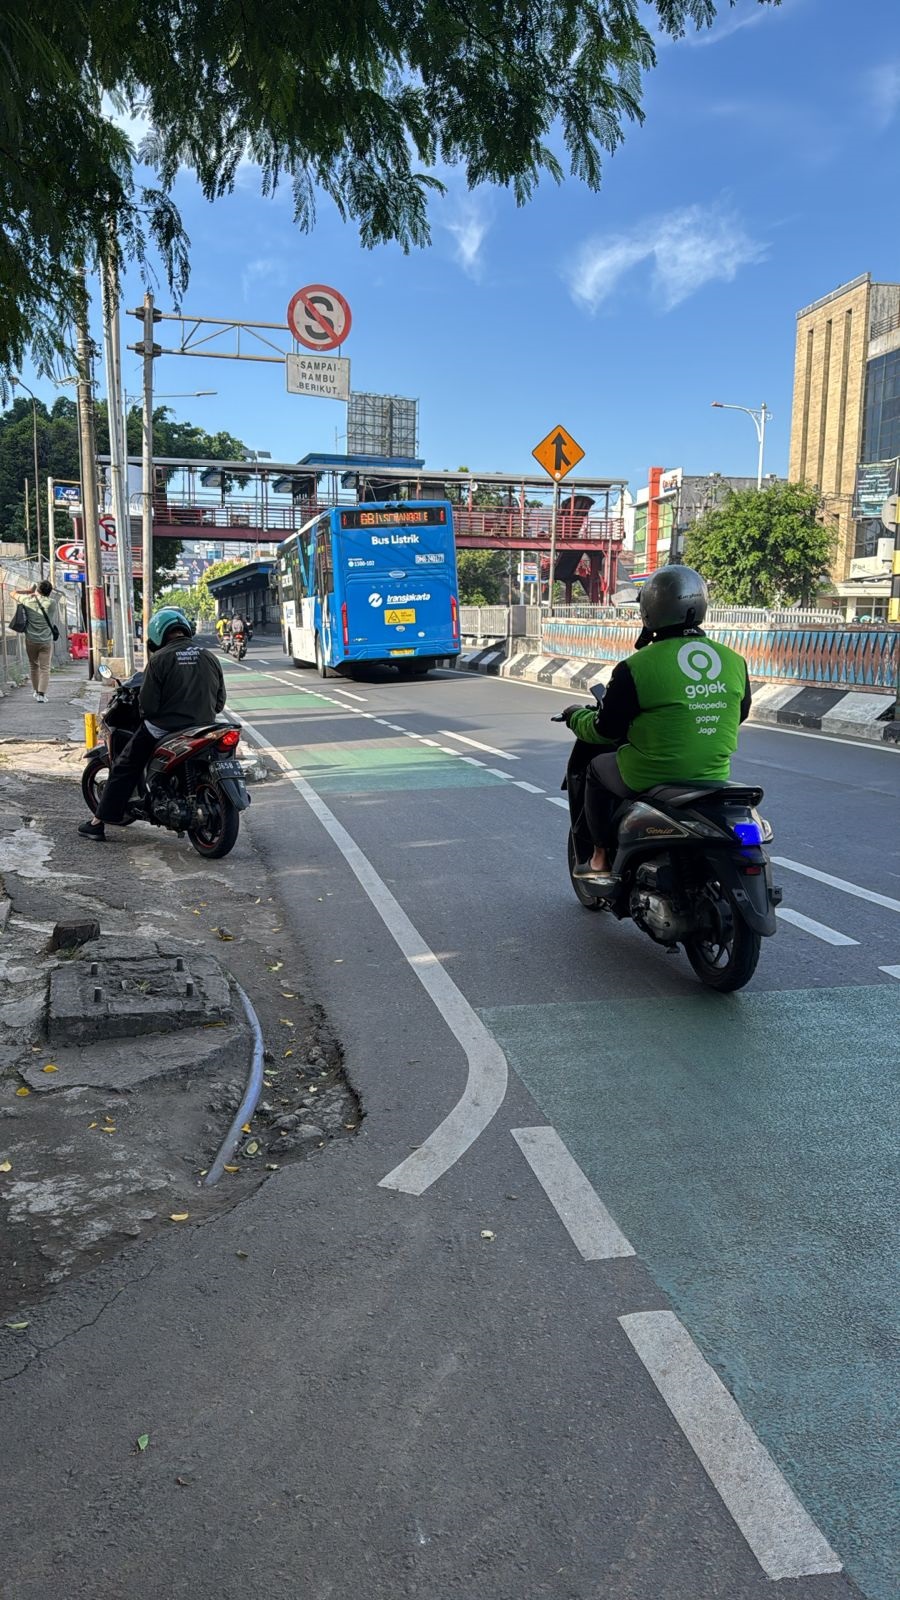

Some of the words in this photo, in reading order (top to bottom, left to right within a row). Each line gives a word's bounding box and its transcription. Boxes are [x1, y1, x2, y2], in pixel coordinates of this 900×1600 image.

[300, 361, 337, 372] SAMPAI
[301, 372, 335, 383] RAMBU
[299, 382, 337, 394] BERIKUT
[371, 536, 389, 545] Bus
[391, 534, 420, 545] Listrik
[685, 681, 727, 699] gojek
[688, 701, 728, 711] tokopedia
[695, 715, 720, 724] gopay
[697, 727, 717, 735] Jago
